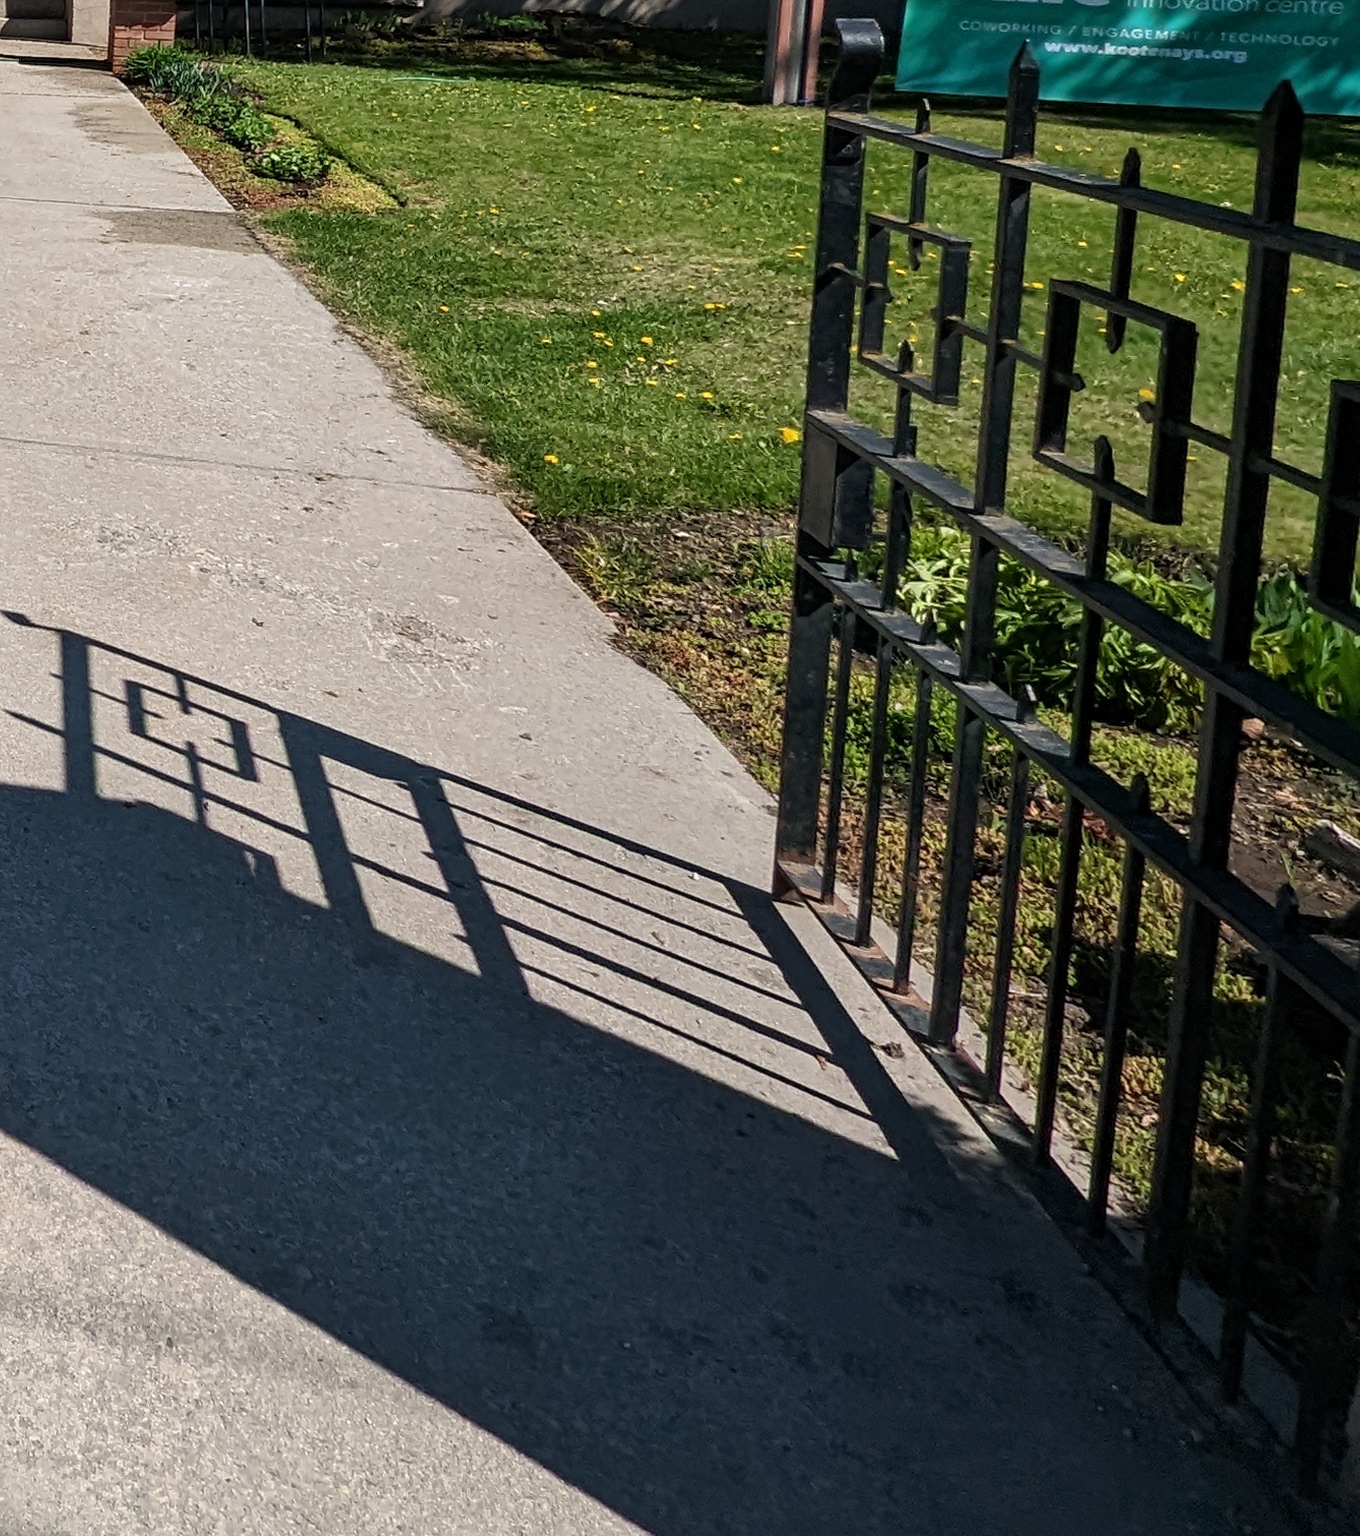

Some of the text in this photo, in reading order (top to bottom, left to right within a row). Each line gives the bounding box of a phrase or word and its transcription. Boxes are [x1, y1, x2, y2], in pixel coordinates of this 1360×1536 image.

[959, 20, 1062, 35] COWORKING
[1082, 25, 1199, 41] ENGAGEMENT
[1220, 31, 1340, 47] TECHNOLOGY
[1044, 41, 1248, 63] www.kootenays.org
